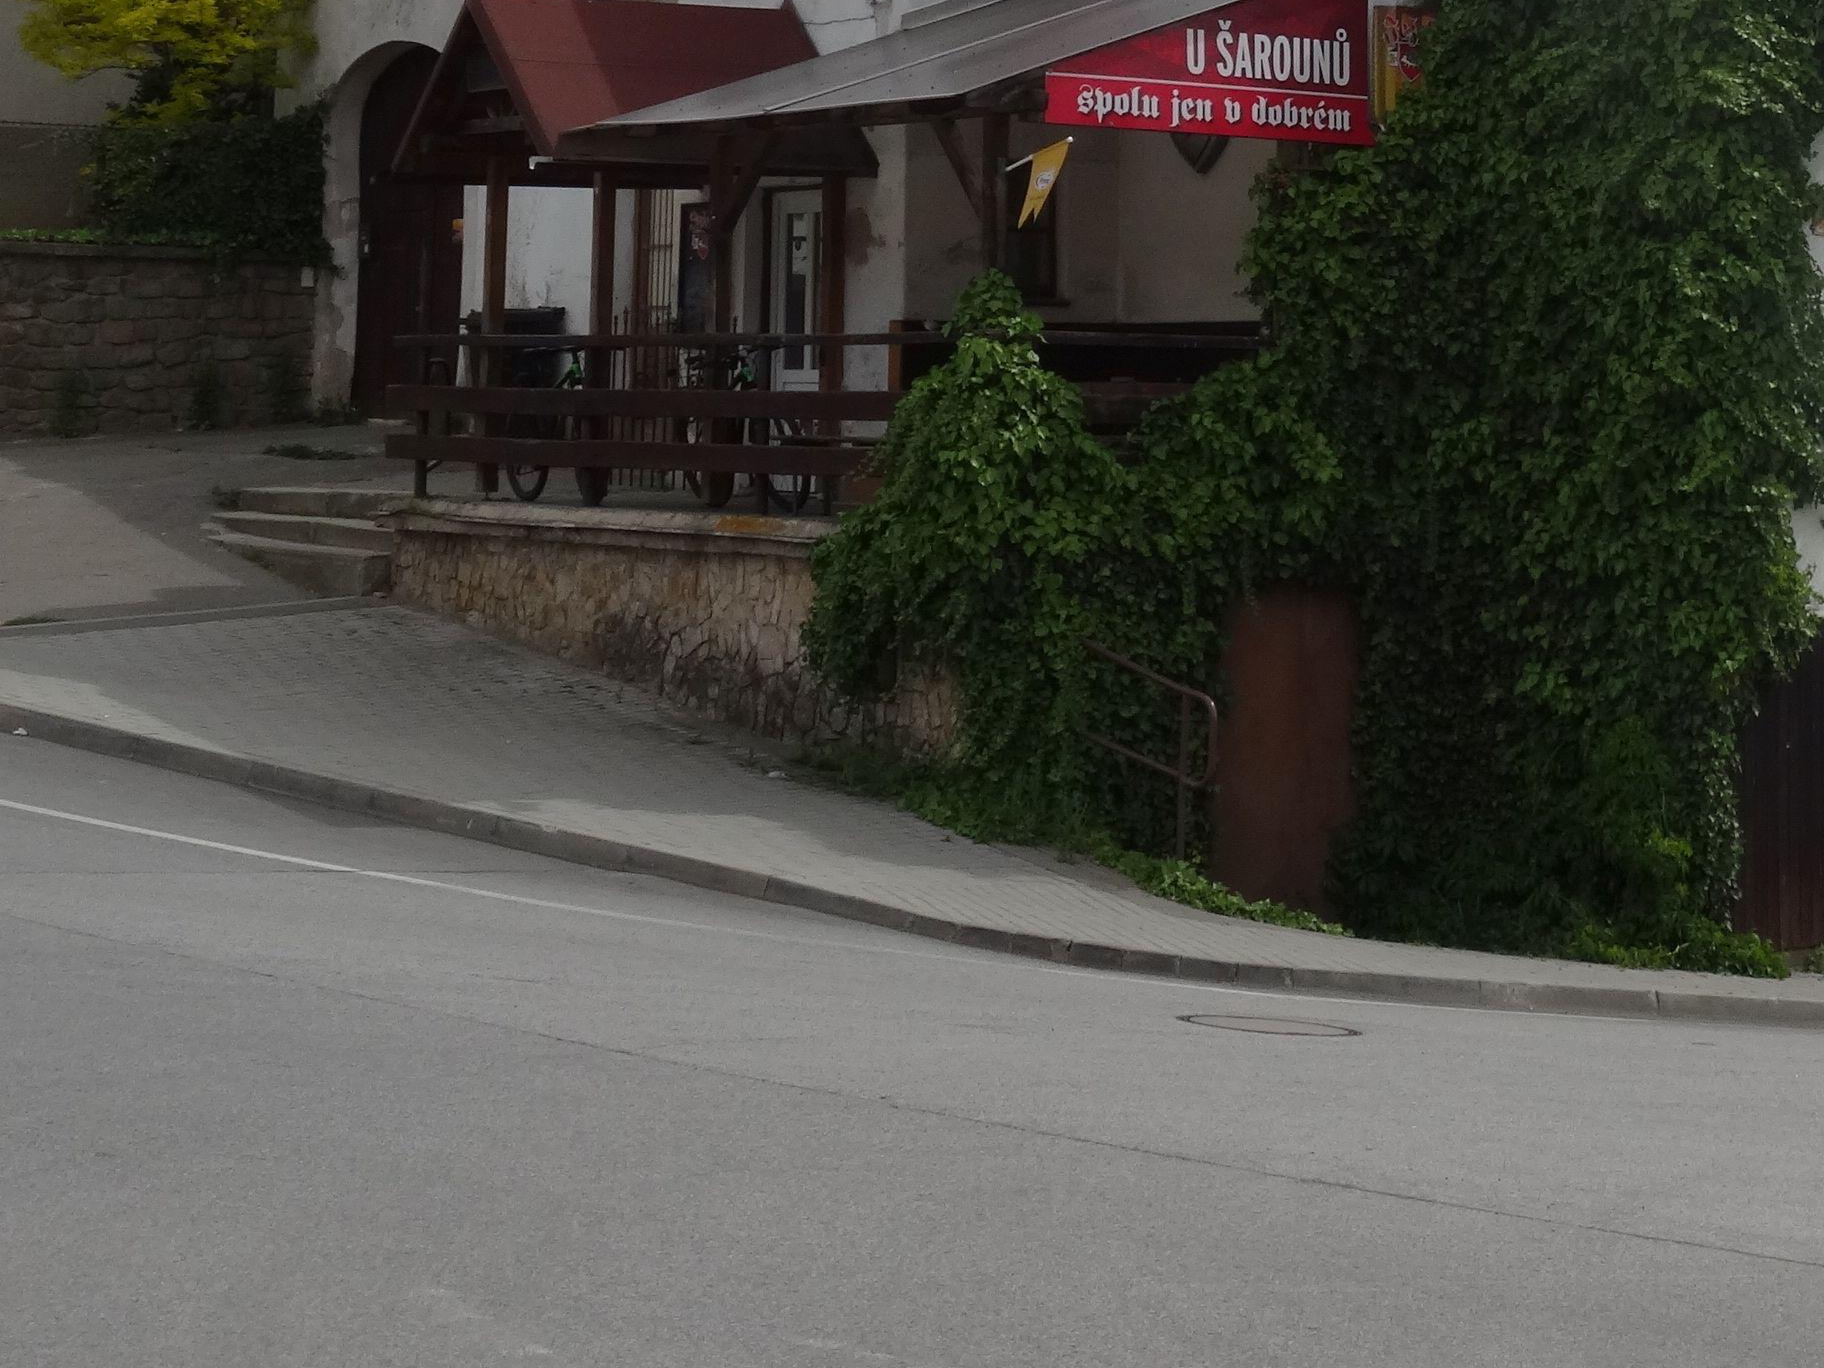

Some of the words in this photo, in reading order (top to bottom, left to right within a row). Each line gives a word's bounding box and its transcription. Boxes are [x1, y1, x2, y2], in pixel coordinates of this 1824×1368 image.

[1186, 28, 1205, 75] U
[1216, 19, 1350, 86] ŠAROUNŮ
[1077, 84, 1160, 123] spolu
[1169, 89, 1213, 127] jen
[1224, 92, 1241, 124] v
[1251, 95, 1351, 131] dobrém
